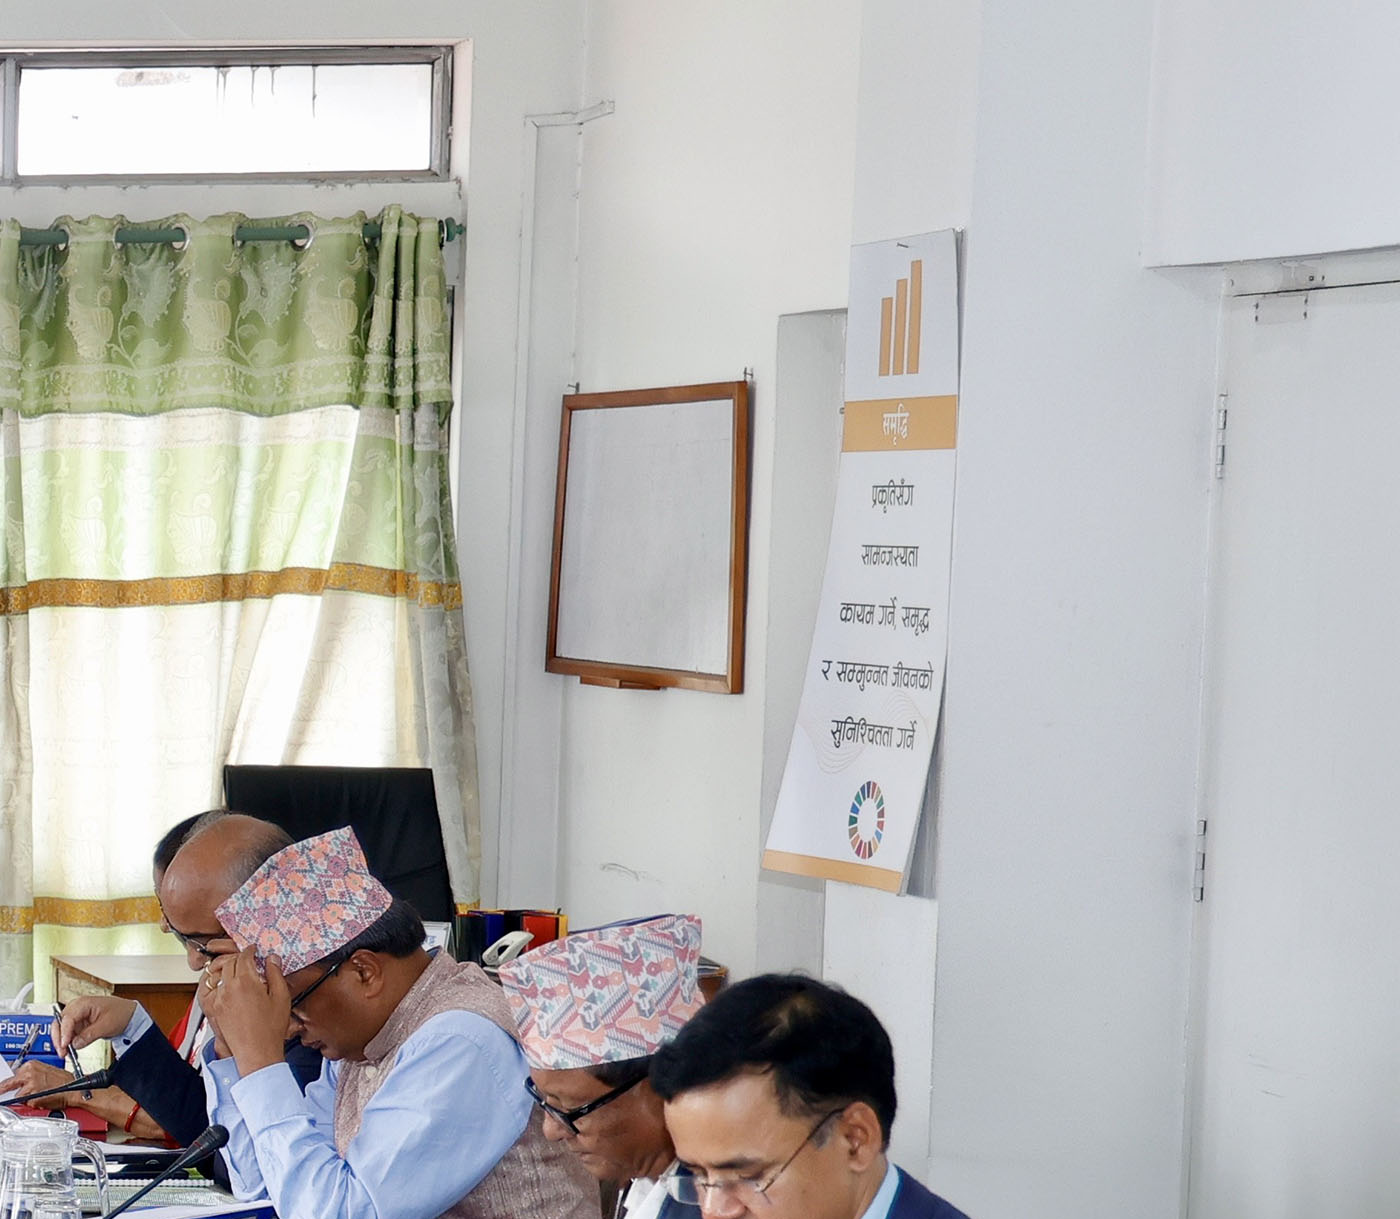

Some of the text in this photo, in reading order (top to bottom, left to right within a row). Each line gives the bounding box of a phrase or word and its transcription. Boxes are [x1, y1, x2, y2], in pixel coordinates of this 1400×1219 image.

[883, 403, 909, 445] समृद्धि
[872, 478, 914, 513] प्रकृतिसँग
[840, 602, 875, 625] कायम
[901, 606, 931, 636] समृद्ध
[822, 660, 934, 691] र सम्मुन्नत जीवनको
[831, 716, 917, 750] सुनिश्चितता गर्ने
